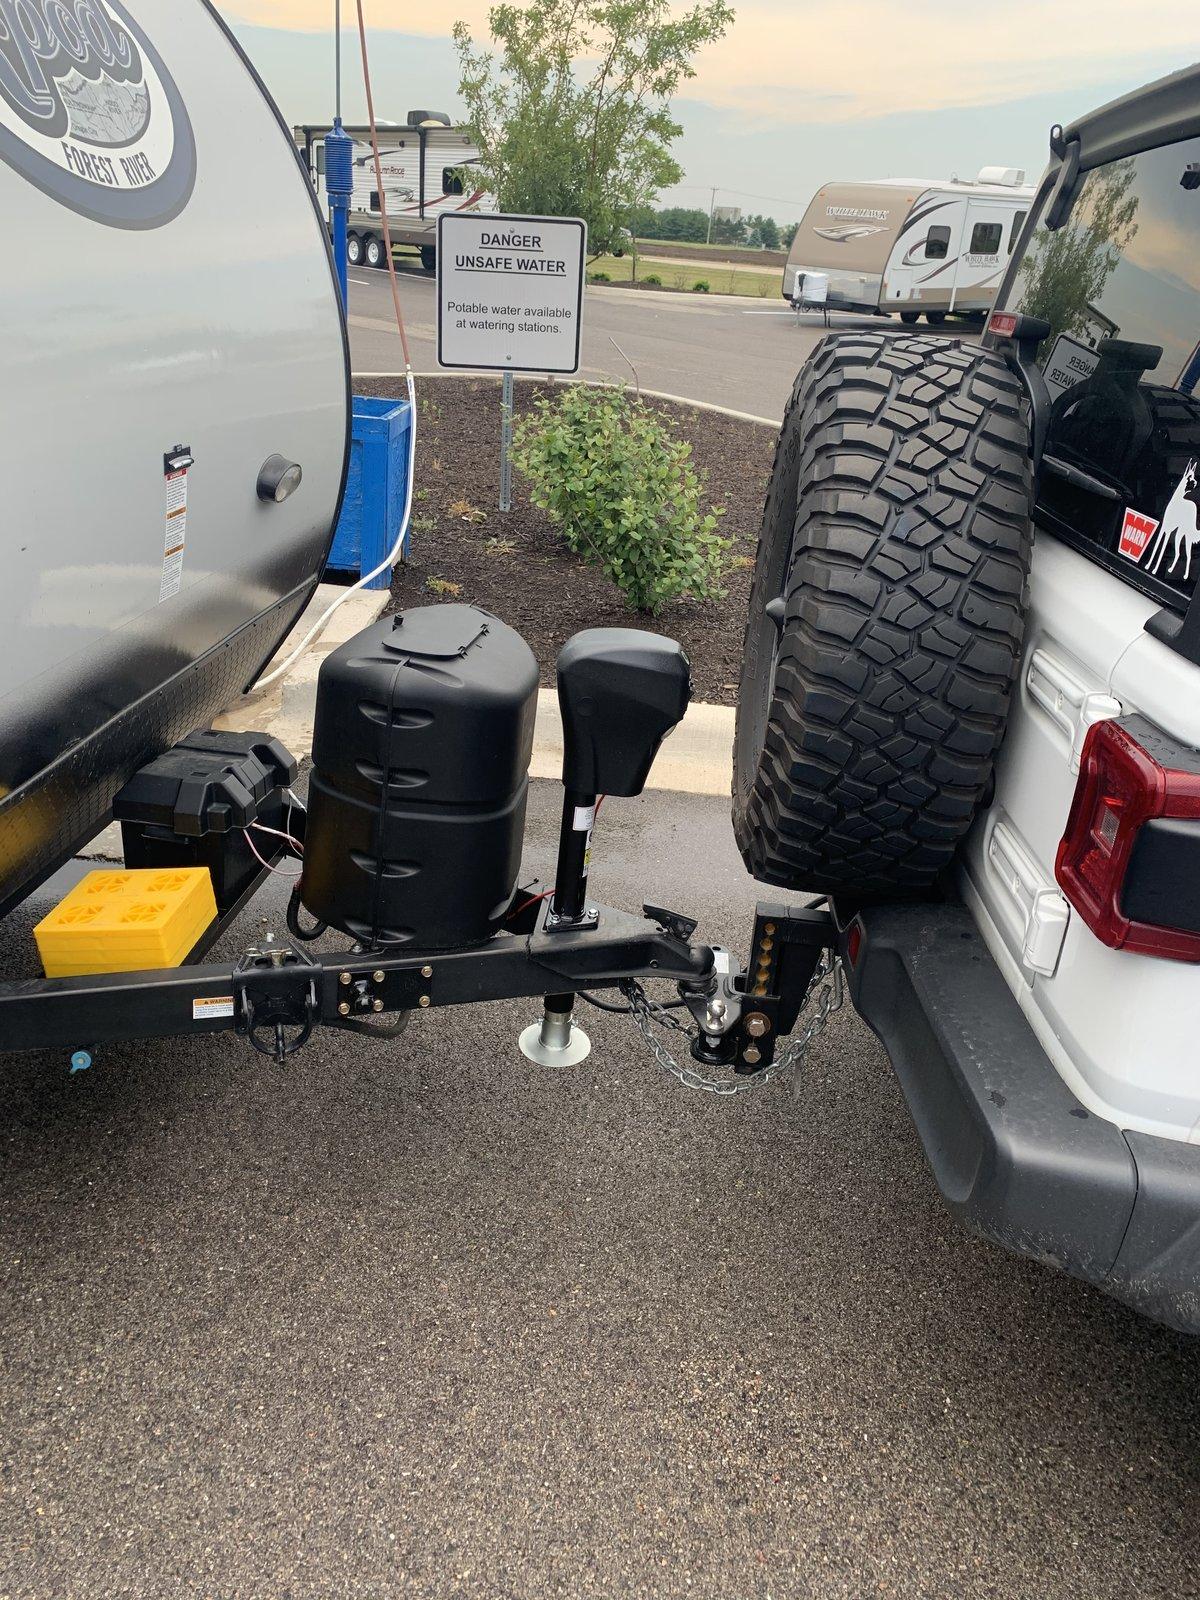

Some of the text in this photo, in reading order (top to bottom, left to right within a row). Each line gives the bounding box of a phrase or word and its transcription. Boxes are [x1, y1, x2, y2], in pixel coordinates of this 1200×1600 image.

[61, 140, 156, 186] FOREST RIVER
[481, 233, 541, 248] DANGER
[455, 255, 566, 273] UNSAFE WATER
[447, 301, 572, 319] Potable water available
[456, 319, 562, 334] at watering stations.
[1123, 524, 1147, 548] WARN
